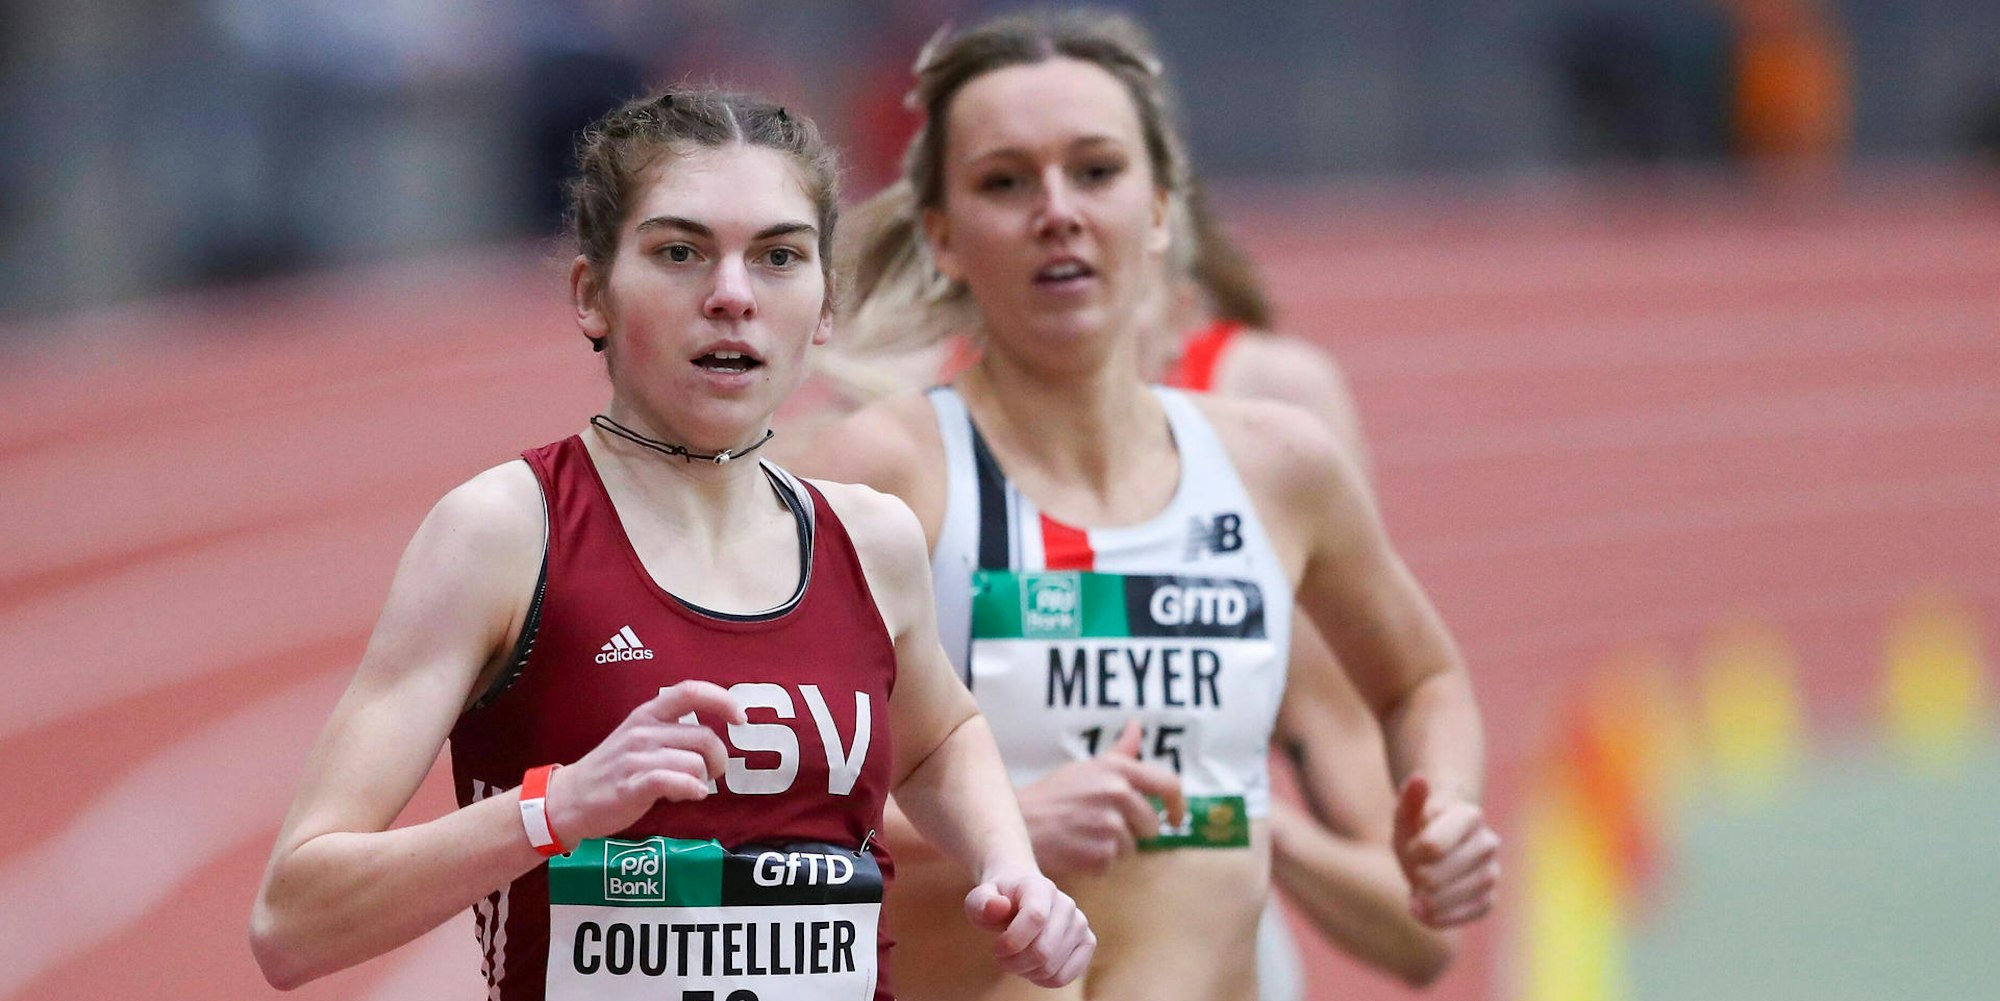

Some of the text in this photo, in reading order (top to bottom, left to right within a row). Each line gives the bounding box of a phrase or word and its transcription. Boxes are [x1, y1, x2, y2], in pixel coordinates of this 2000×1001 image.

[1150, 585, 1248, 627] GfTD
[595, 648, 654, 664] adidas
[1046, 647, 1222, 708] MEYER
[658, 682, 873, 796] SV
[1080, 725, 1186, 775] 15
[621, 854, 660, 876] psd
[752, 851, 855, 887] GfTD
[610, 877, 660, 896] Bank
[573, 920, 857, 978] COUTTELLIER
